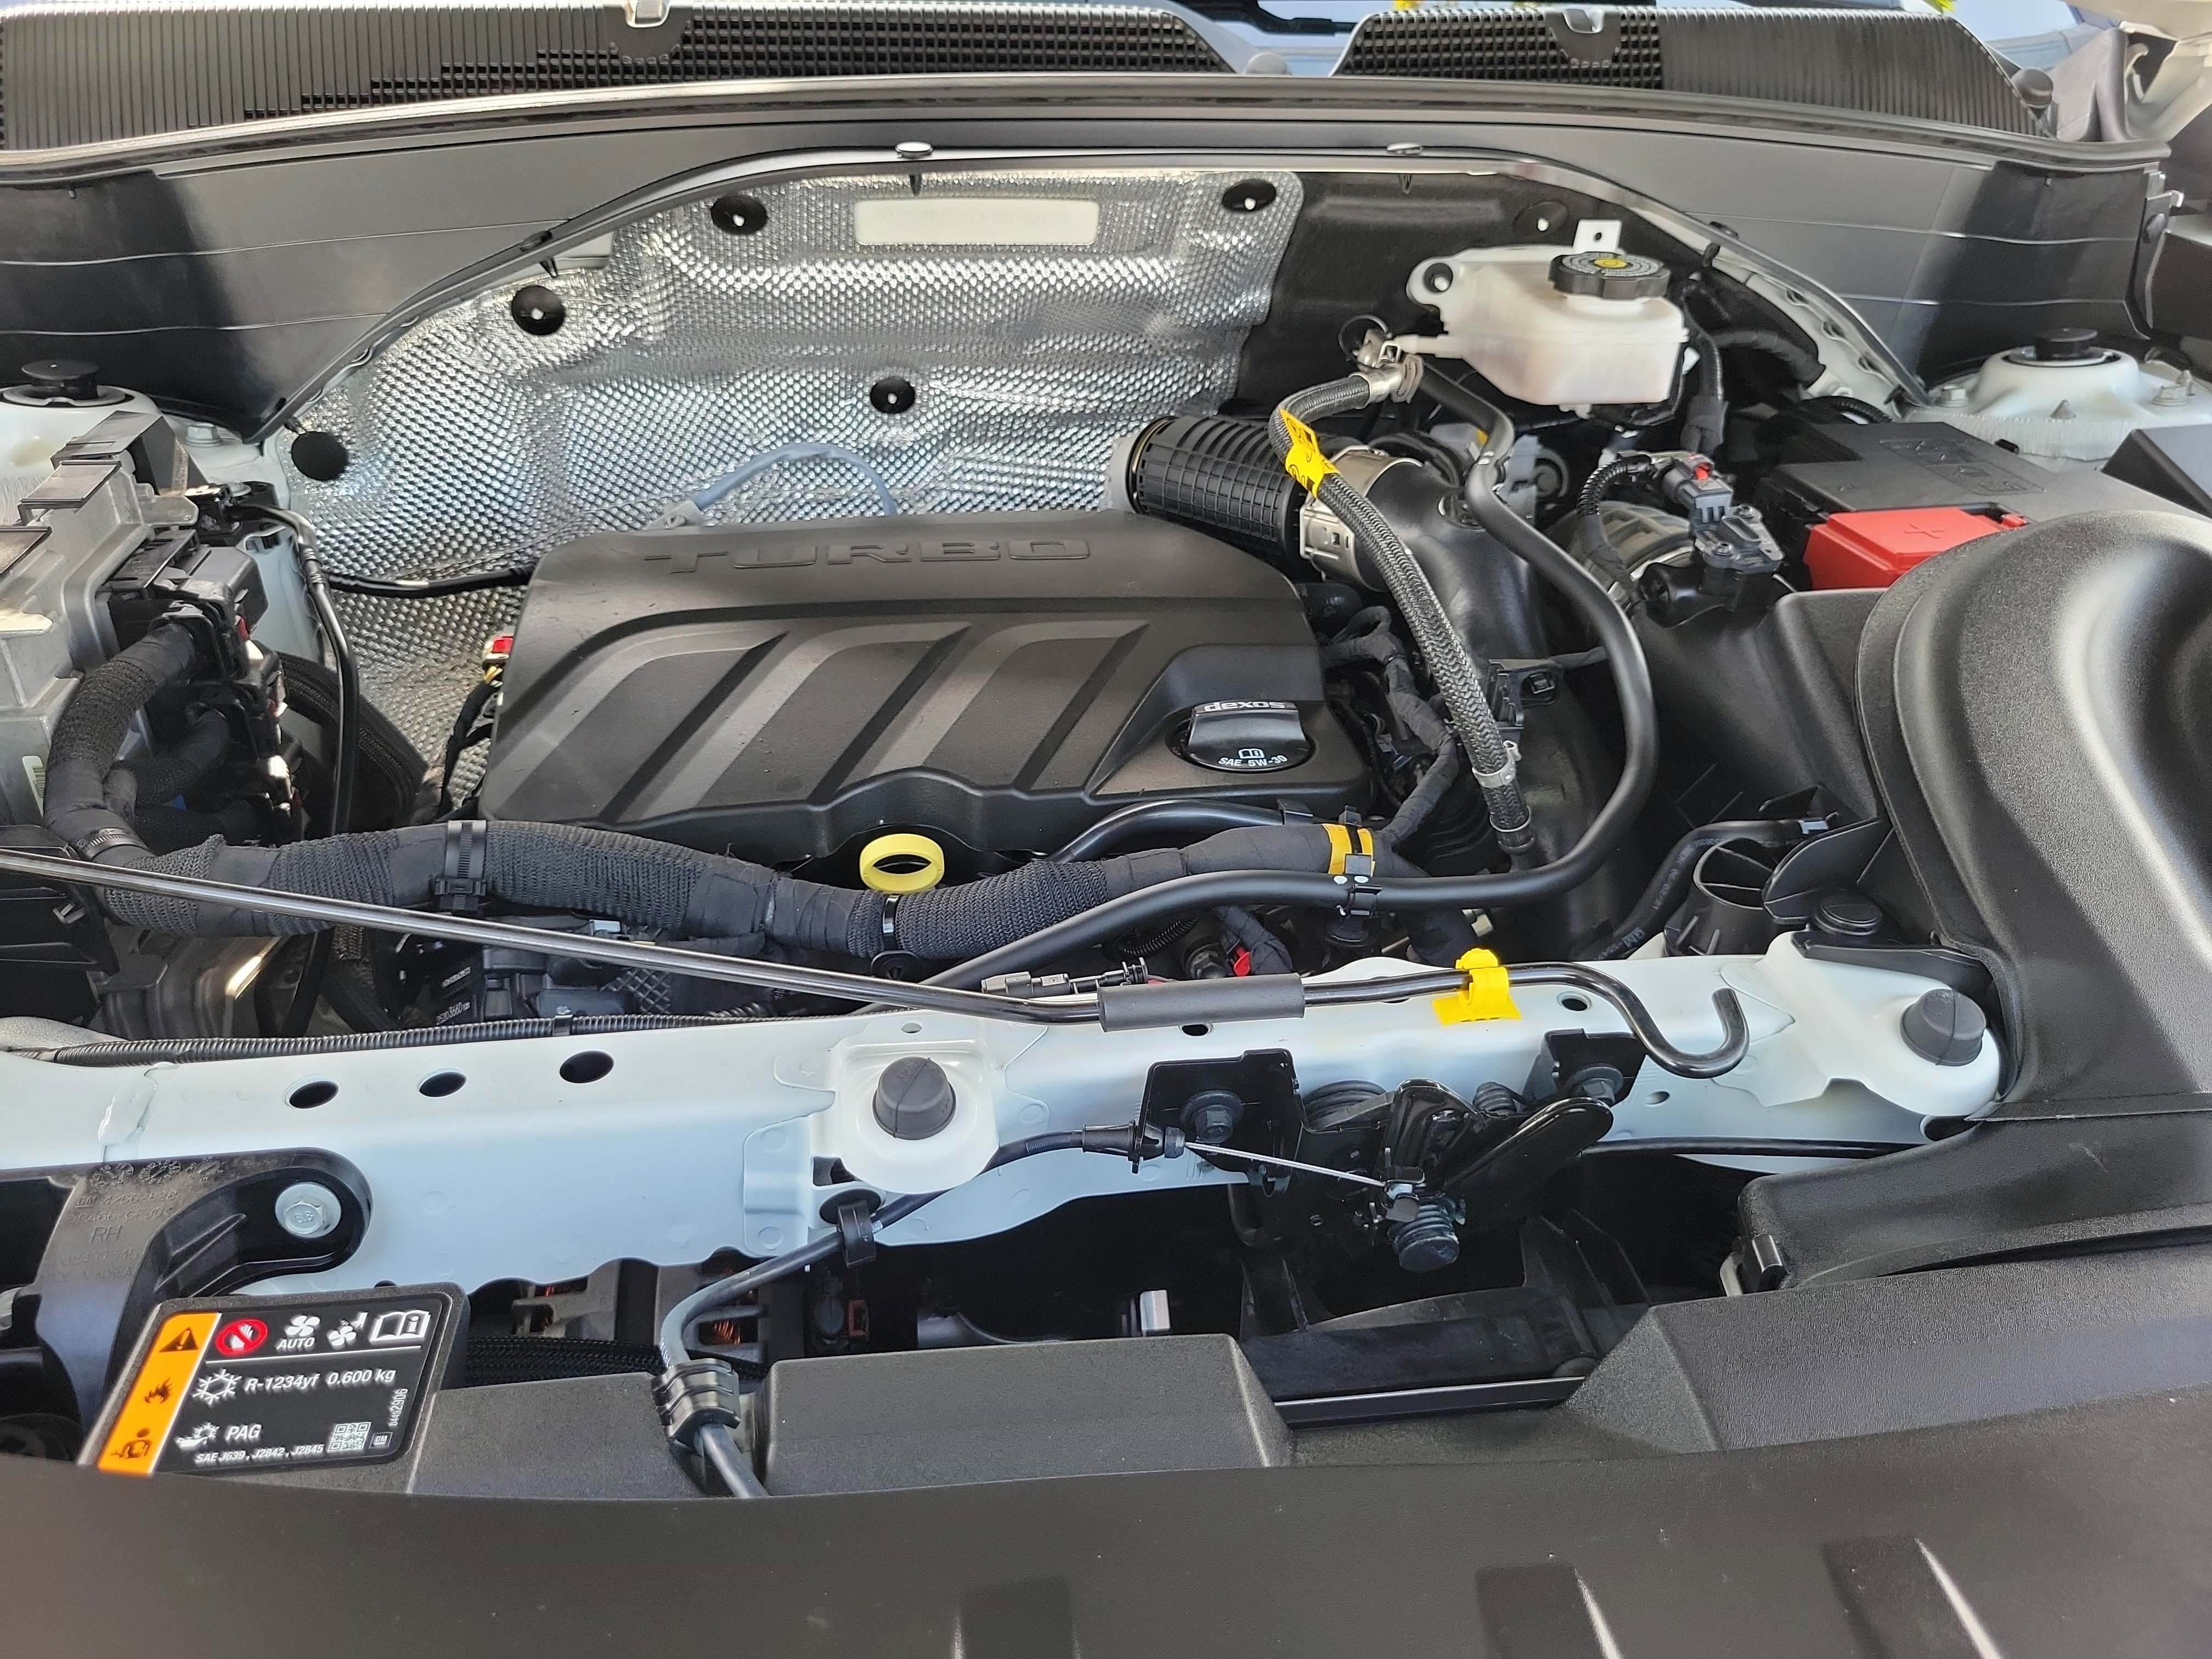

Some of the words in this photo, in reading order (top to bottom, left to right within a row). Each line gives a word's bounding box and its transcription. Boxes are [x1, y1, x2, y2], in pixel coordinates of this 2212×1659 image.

[645, 540, 1091, 574] TURBO
[1204, 701, 1286, 712] dexos
[1218, 757, 1242, 766] SAE
[1248, 755, 1288, 767] 5W-30
[91, 1224, 122, 1244] RH
[276, 1336, 315, 1351] AUTO
[244, 1373, 320, 1392] R-1234yf
[326, 1369, 373, 1385] 0.600
[375, 1368, 397, 1382] kg
[389, 1388, 409, 1426] 84492906
[225, 1423, 263, 1442] PAG
[375, 1435, 388, 1445] GM
[195, 1452, 219, 1463] SAE
[292, 1443, 325, 1455] J2845
